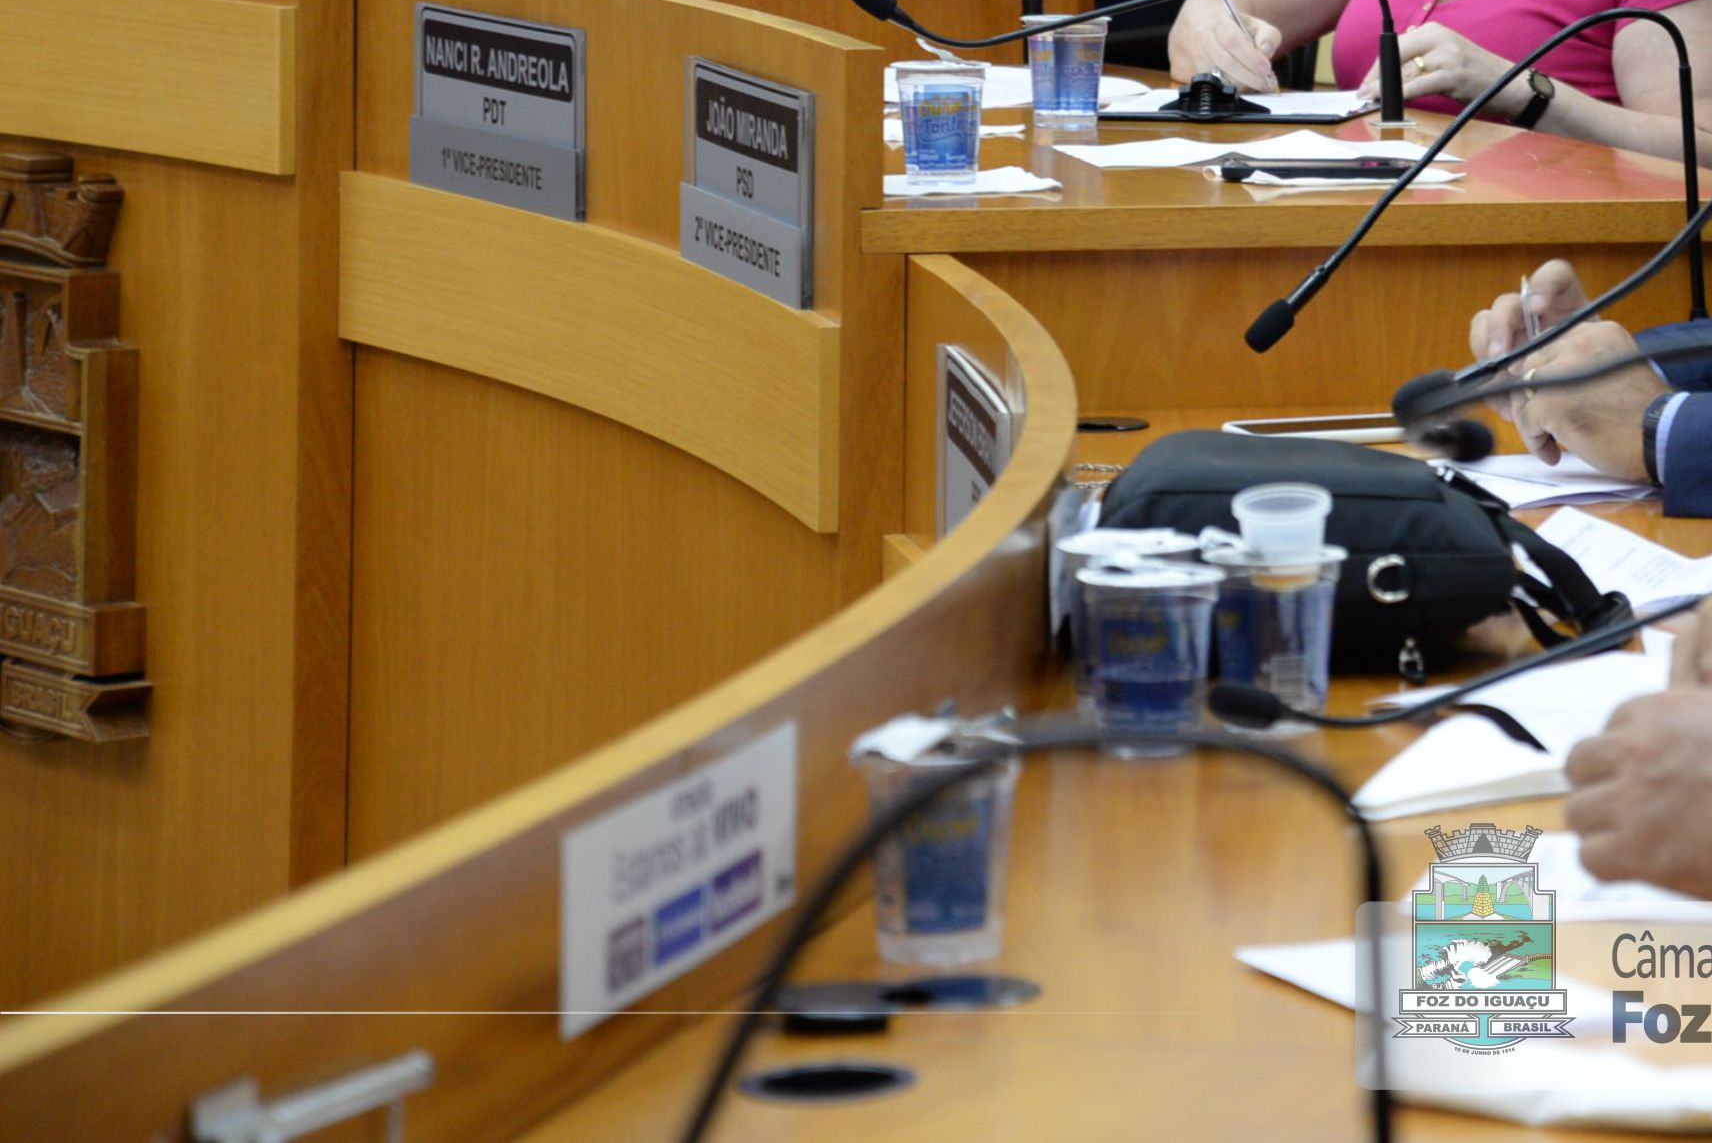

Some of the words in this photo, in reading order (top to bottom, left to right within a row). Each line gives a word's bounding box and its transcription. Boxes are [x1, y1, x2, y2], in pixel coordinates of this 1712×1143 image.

[426, 35, 467, 71] NANCI
[471, 45, 484, 75] R.
[487, 48, 569, 93] ANDREOLA
[483, 97, 506, 126] PDT
[706, 97, 734, 140] JOÃO
[736, 110, 789, 160] MIRANDA
[453, 150, 542, 190] VICE-PRESIDENTE
[736, 166, 754, 199] PSD
